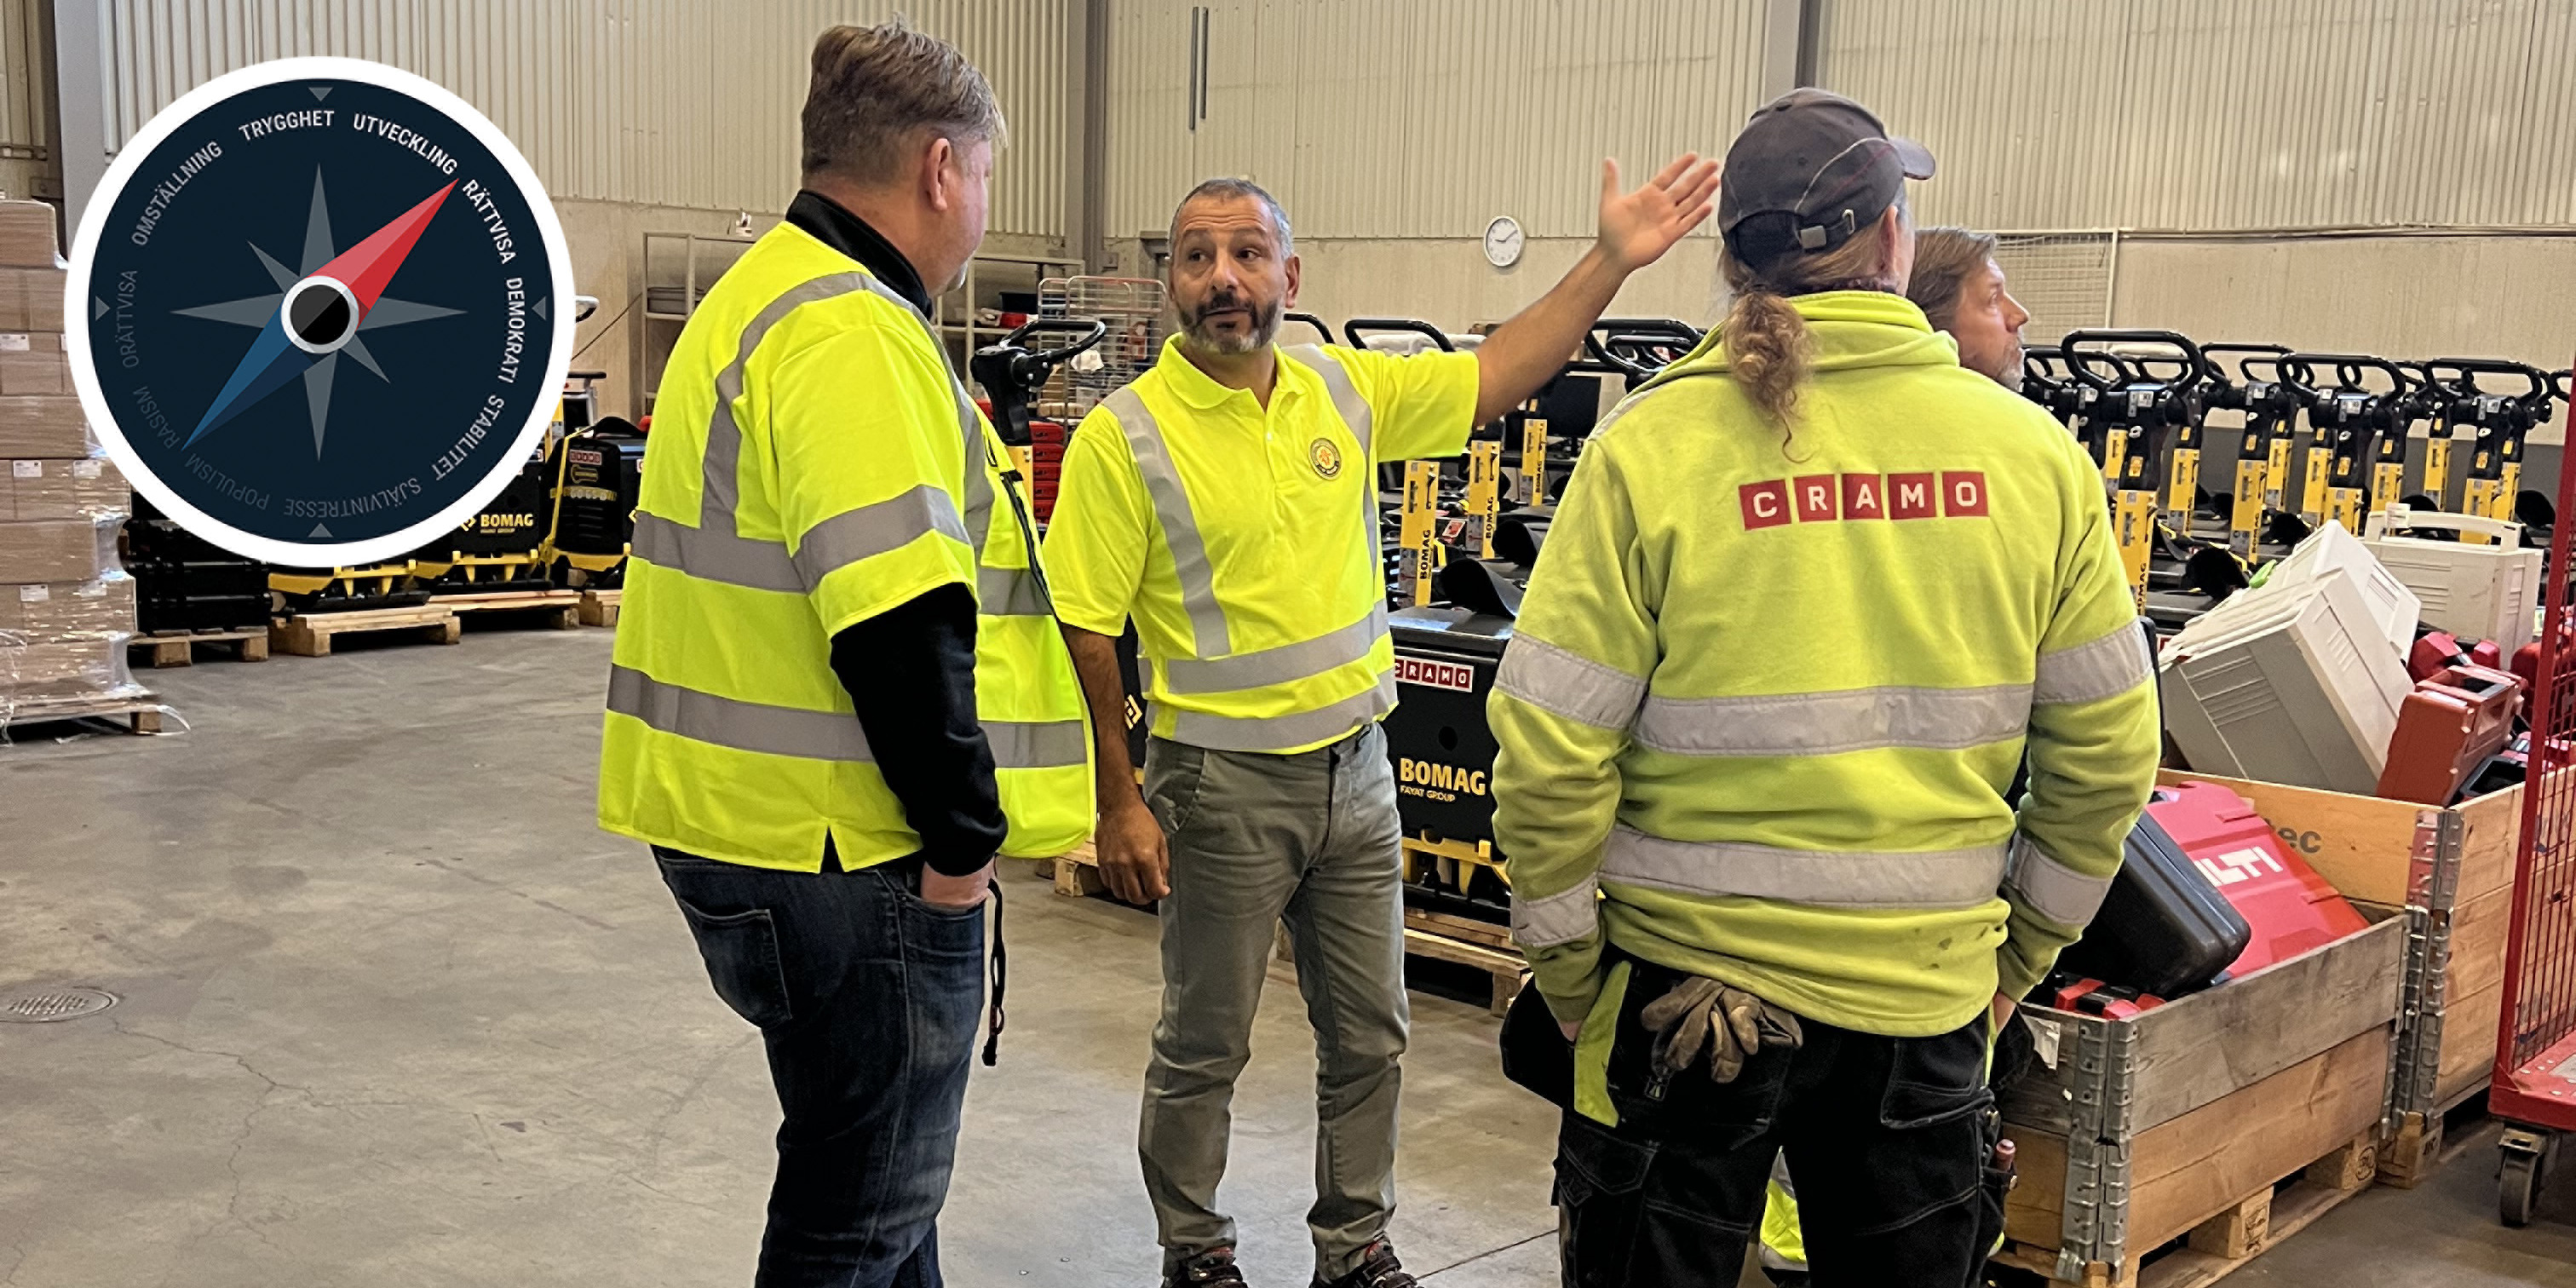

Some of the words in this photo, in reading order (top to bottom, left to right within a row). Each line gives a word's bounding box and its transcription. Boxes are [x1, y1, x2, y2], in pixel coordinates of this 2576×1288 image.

[1486, 496, 1494, 539] BOMAG
[1753, 481, 1977, 518] CRAMO
[480, 514, 534, 526] BOMAG
[1419, 529, 1431, 579] BOMAG
[1395, 662, 1467, 685] CRAMO
[1400, 757, 1486, 796] BOMAG
[2194, 846, 2284, 888] ILTI
